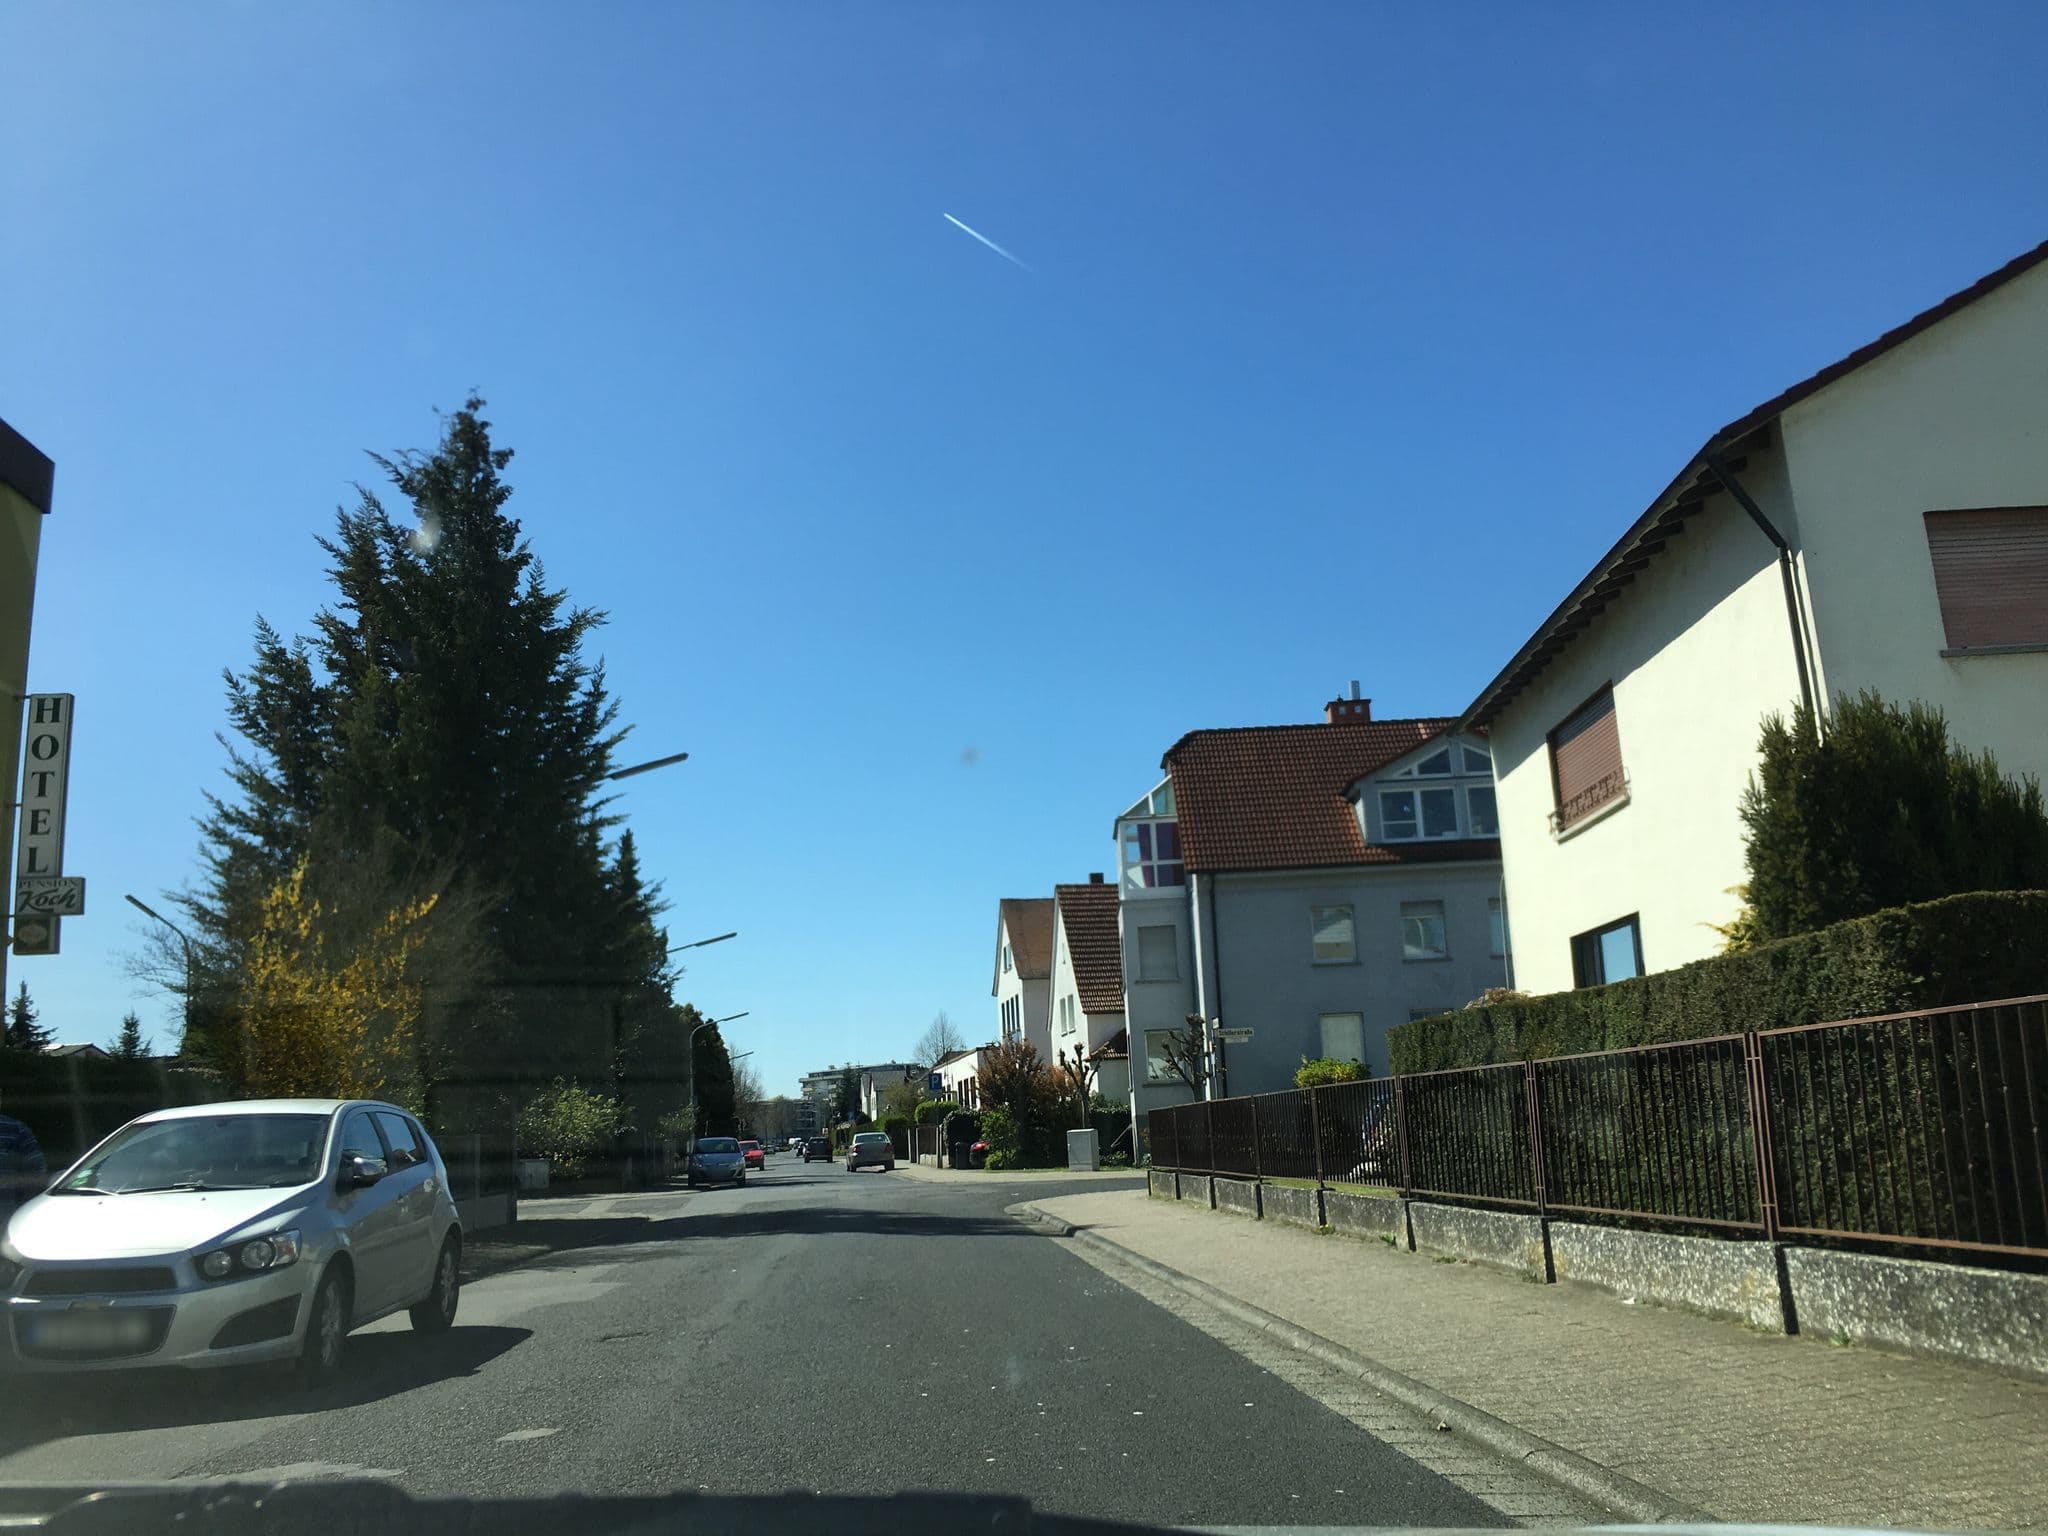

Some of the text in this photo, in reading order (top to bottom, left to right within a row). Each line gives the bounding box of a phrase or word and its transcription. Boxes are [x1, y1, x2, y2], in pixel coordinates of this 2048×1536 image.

[27, 697, 63, 873] HOTEL
[18, 888, 76, 912] Koch
[931, 1072, 940, 1089] P
